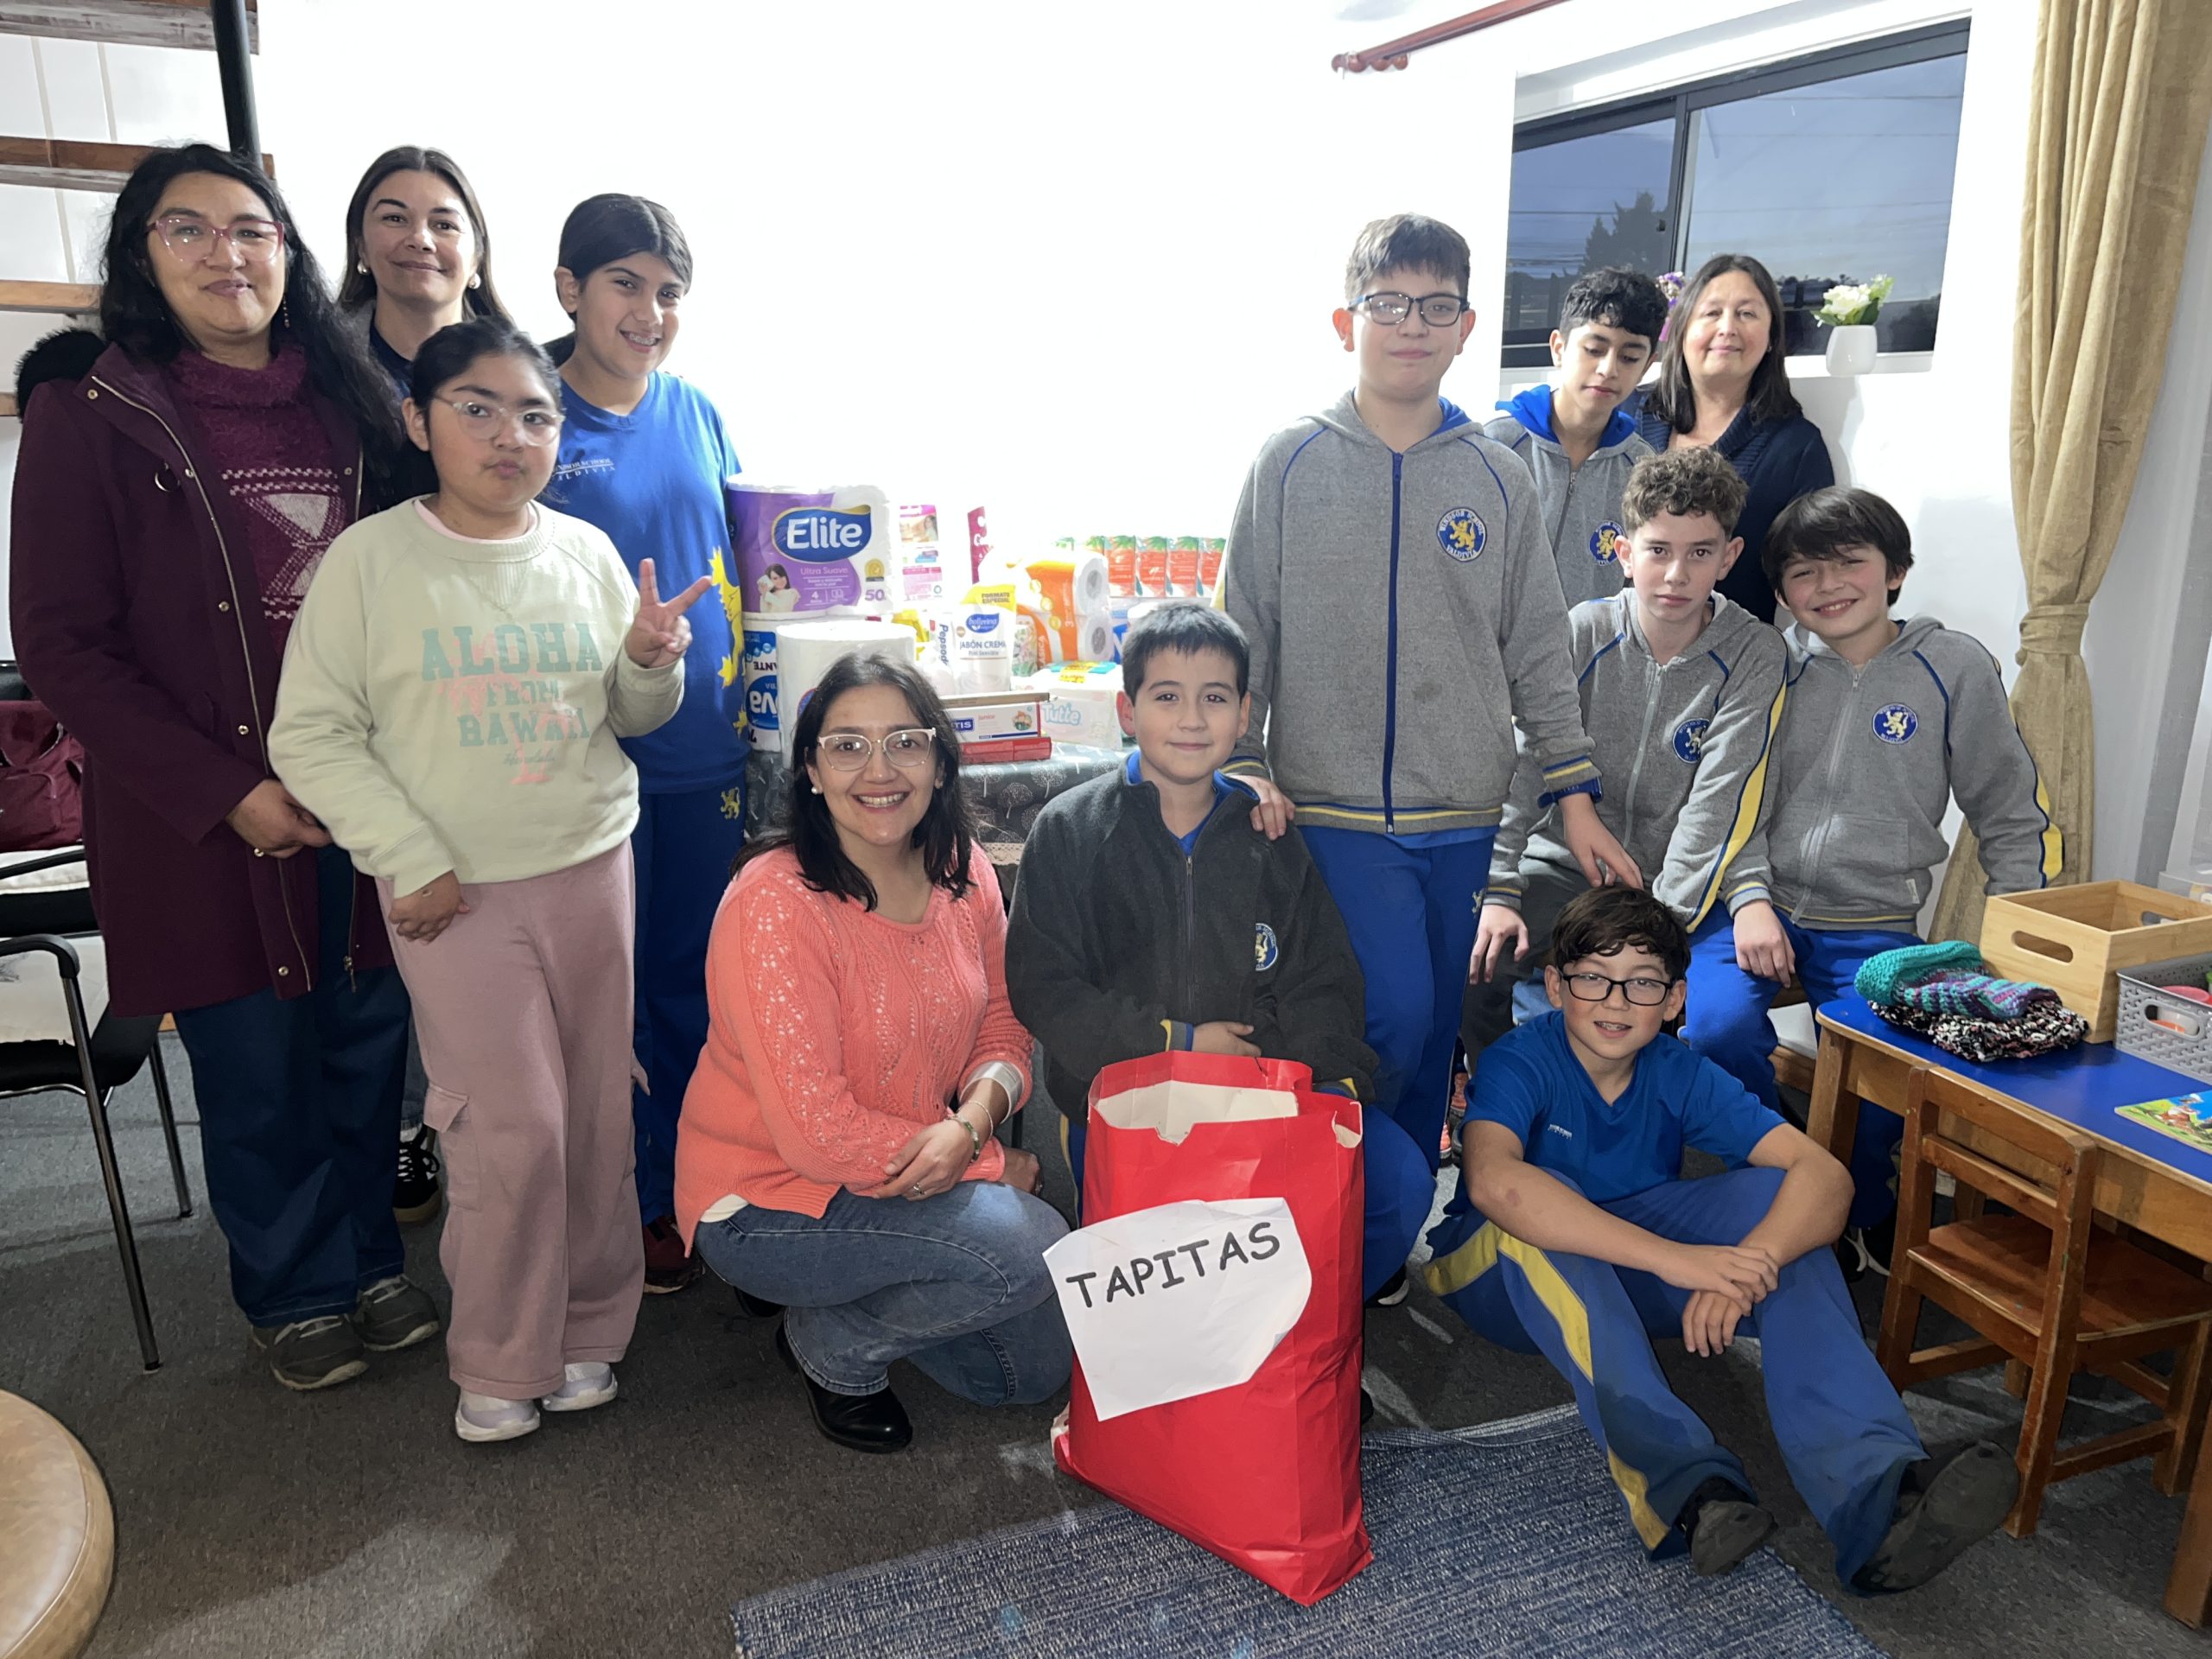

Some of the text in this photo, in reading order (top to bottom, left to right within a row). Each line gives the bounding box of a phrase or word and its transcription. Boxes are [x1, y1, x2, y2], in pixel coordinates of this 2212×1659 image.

[558, 466, 615, 481] ALDIVIA
[786, 516, 862, 550] Elite
[864, 589, 886, 601] 50
[421, 622, 603, 681] ALOHA
[959, 639, 982, 650] JABÓN
[486, 679, 560, 707] FROM
[749, 690, 778, 715] va
[1065, 1222, 1280, 1308] TAPITAS
